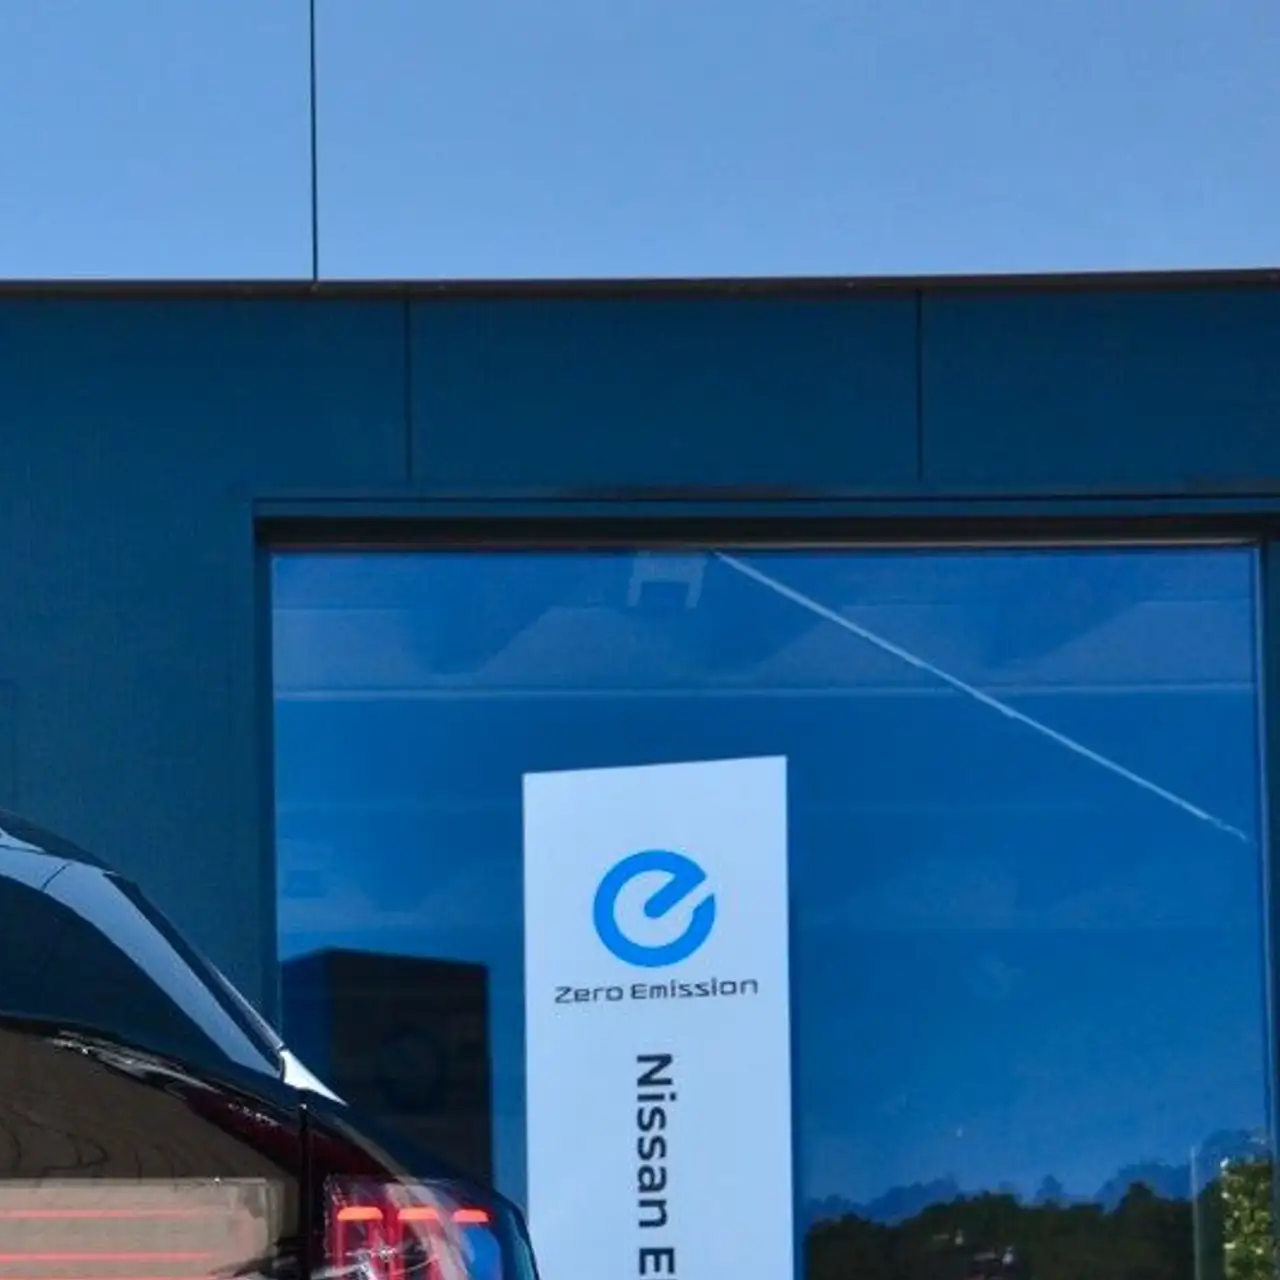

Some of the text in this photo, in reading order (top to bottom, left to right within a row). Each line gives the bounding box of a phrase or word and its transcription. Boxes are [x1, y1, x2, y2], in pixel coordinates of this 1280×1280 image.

[554, 977, 759, 1004] Zero Emission
[636, 1053, 677, 1228] Nissan
